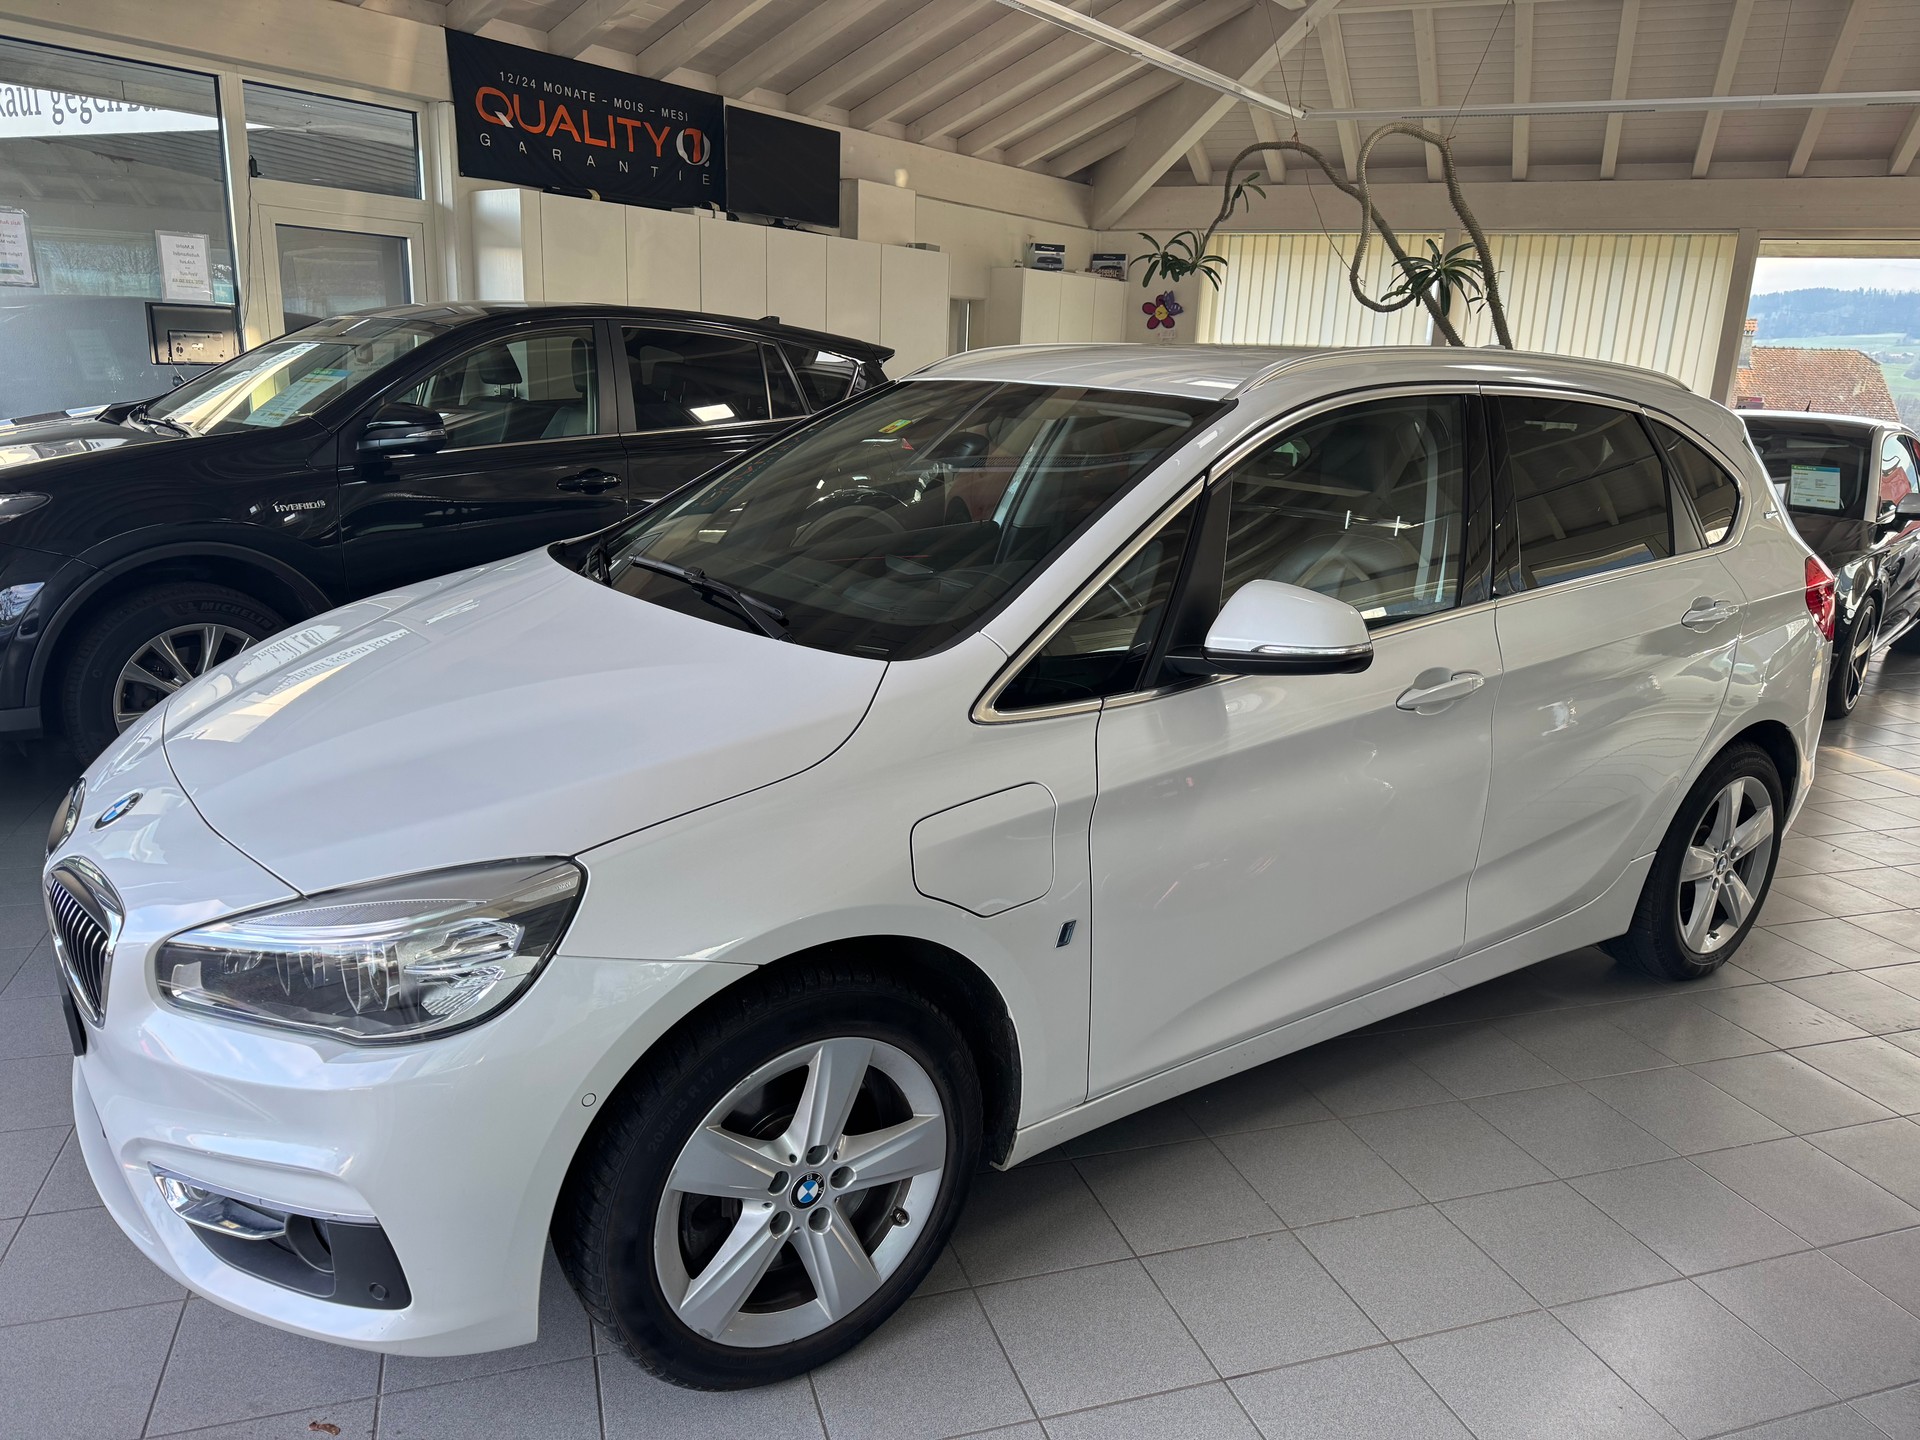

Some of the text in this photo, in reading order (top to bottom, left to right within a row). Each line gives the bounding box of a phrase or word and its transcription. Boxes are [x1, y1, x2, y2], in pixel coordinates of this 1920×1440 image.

[475, 86, 671, 158] QUALITY
[500, 71, 537, 89] 12/24
[543, 82, 596, 103] MONATE
[614, 98, 644, 113] MOIS
[661, 108, 688, 122] MESI
[479, 133, 710, 185] GARANTIE
[200, 601, 273, 629] MICHELIN
